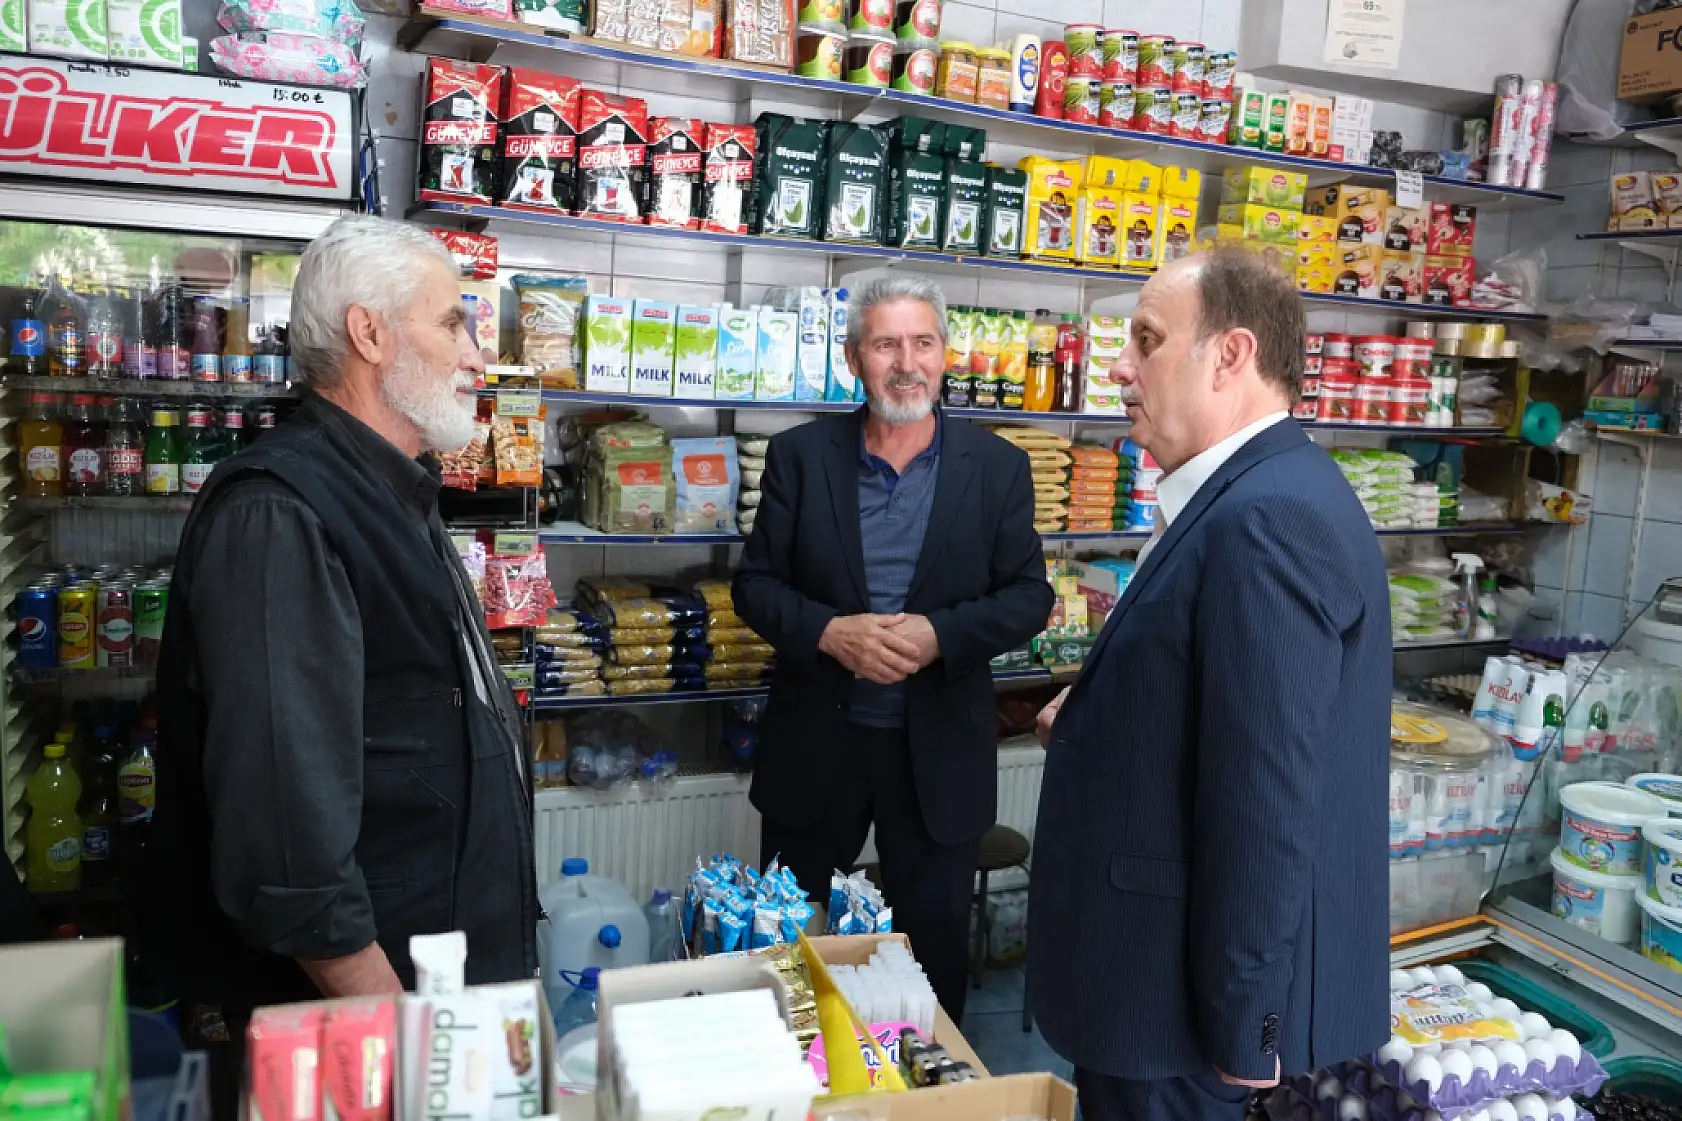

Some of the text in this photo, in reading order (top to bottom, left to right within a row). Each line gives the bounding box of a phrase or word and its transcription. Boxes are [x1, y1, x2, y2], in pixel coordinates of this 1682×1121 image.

[0, 70, 336, 187] ÜLKER
[591, 363, 627, 378] MILK
[635, 366, 670, 382] MILK
[679, 371, 712, 386] MILK
